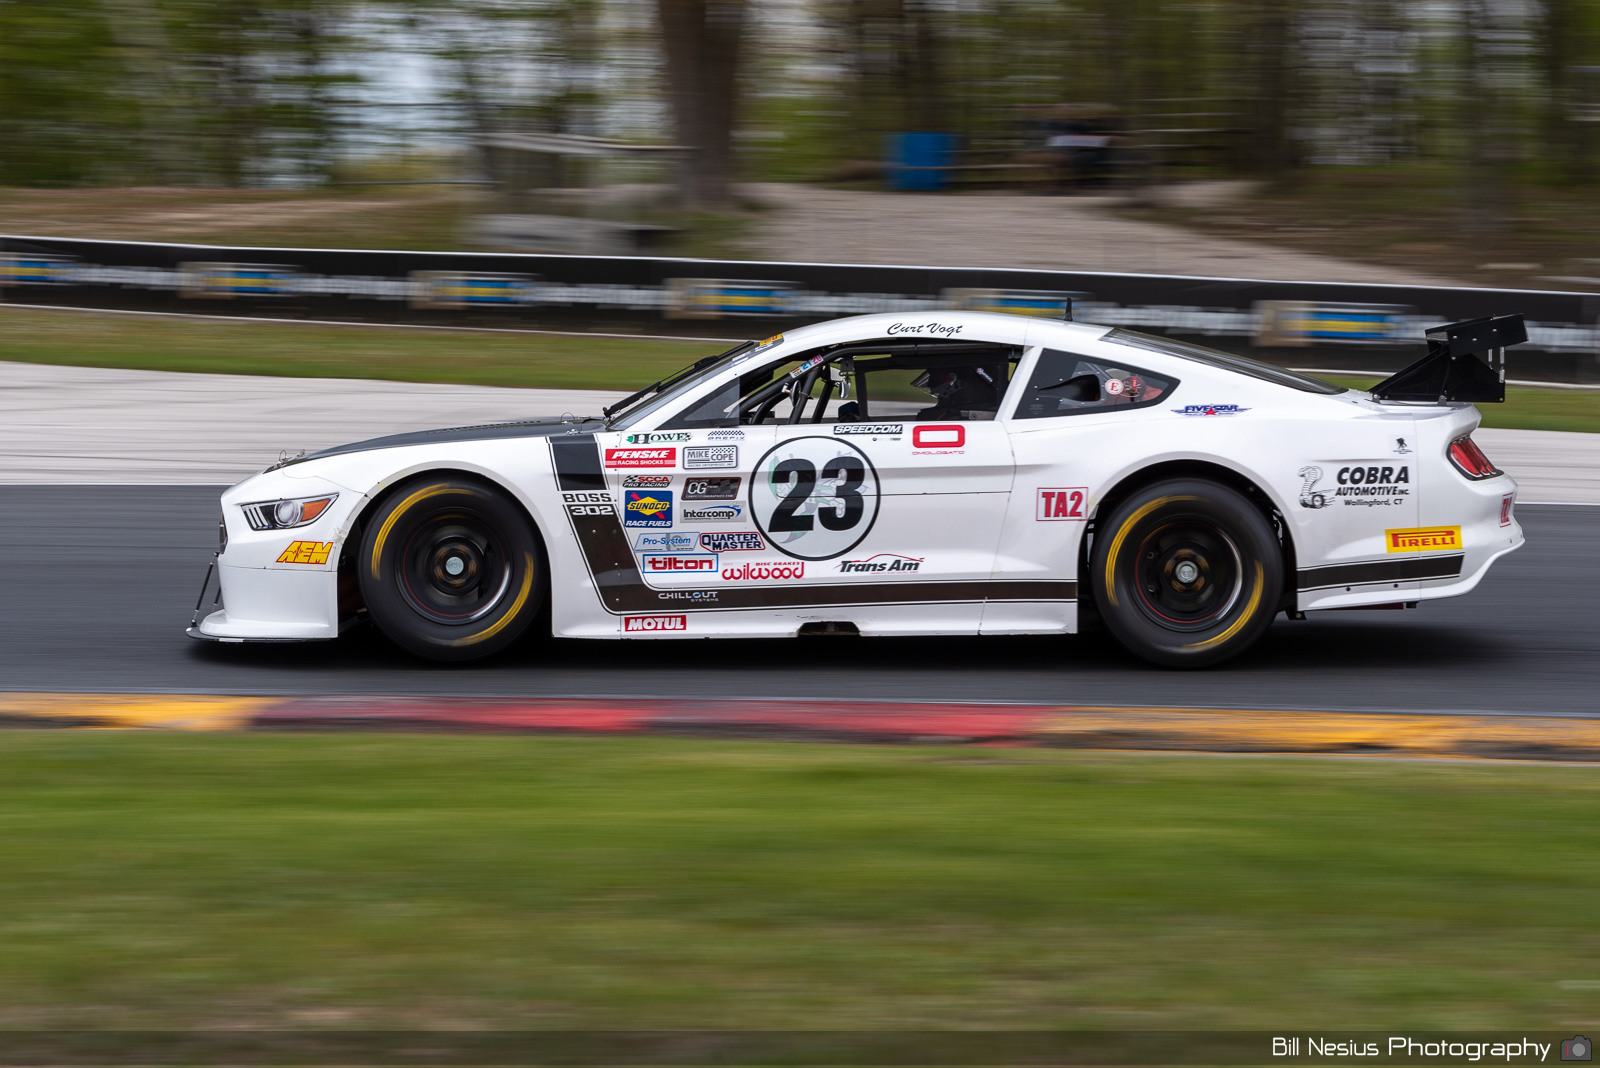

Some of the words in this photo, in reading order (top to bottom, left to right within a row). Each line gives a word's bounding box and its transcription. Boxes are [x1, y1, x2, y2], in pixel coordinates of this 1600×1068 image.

[887, 322, 924, 336] Curt
[926, 322, 963, 337] Vogt
[1110, 382, 1119, 391] E
[632, 433, 685, 444] HOWE
[612, 450, 670, 459] PENSKE
[687, 450, 710, 458] MIKE
[711, 453, 734, 461] COPE
[1337, 466, 1409, 485] COBRA
[688, 482, 708, 494] CG
[1335, 486, 1398, 496] AUTOMOTIVE
[562, 493, 612, 502] BOSS
[768, 456, 865, 532] 23
[628, 502, 669, 511] SUNOCO
[1042, 491, 1083, 517] TA2
[1344, 499, 1391, 507] Wallingford,
[570, 506, 614, 516] 302
[684, 509, 735, 519] Intercomp
[643, 537, 691, 545] Pro-System
[701, 534, 758, 546] QUARTER
[1391, 530, 1455, 547] PIRELLI
[712, 541, 762, 550] MASTER
[276, 541, 333, 564] AEM
[648, 557, 713, 570] tilton
[840, 560, 887, 573] Trans
[887, 559, 920, 572] Am
[722, 562, 804, 580] wilwood
[628, 618, 684, 631] MOTUL
